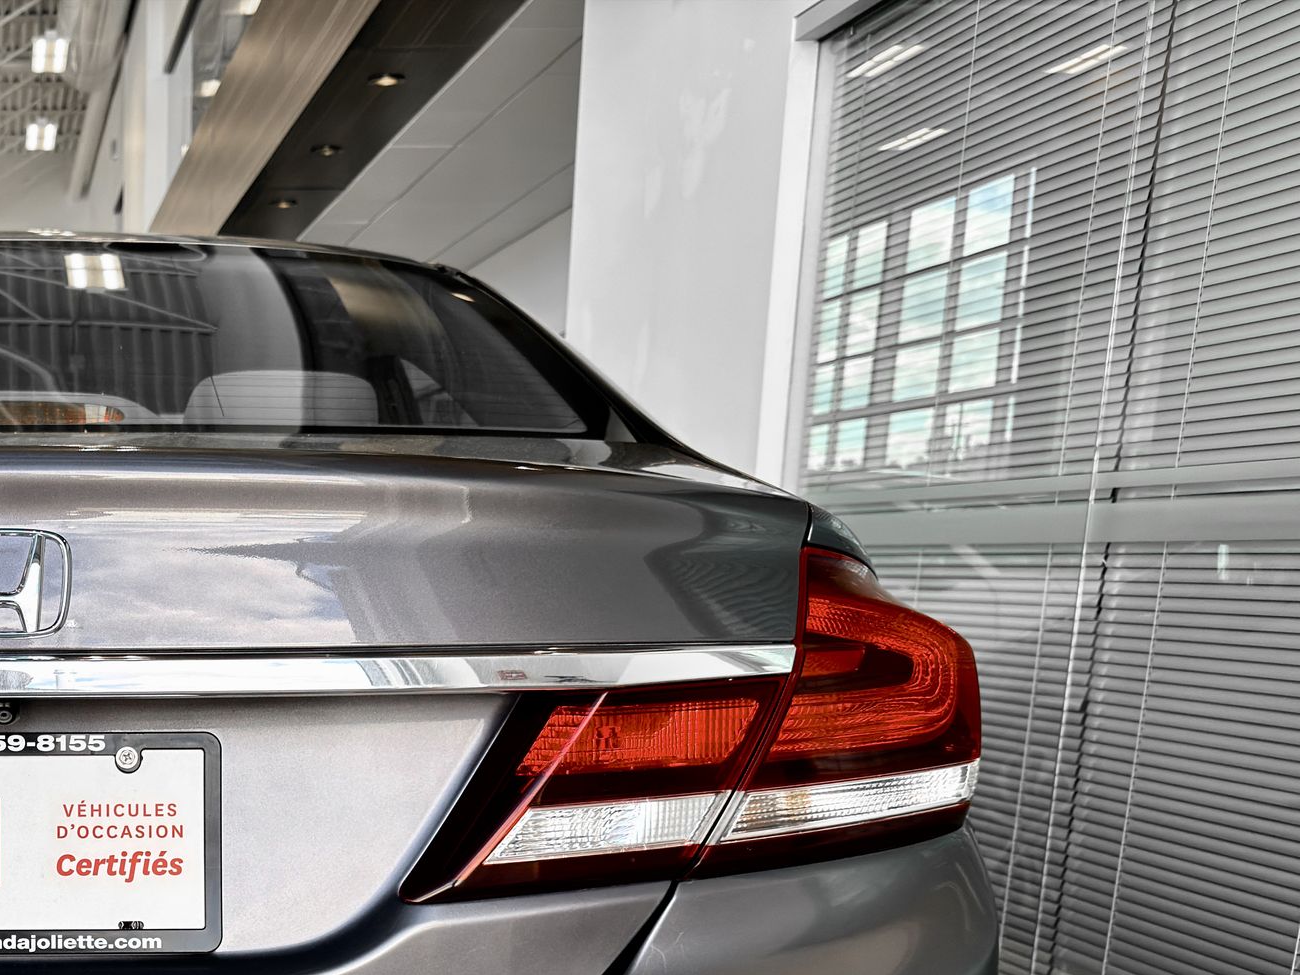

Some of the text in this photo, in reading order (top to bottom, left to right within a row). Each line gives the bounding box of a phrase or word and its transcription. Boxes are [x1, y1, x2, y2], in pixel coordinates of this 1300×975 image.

[62, 799, 178, 818] VÉHICULES
[56, 823, 185, 839] D’OCCASION
[56, 850, 184, 883] Certifiés
